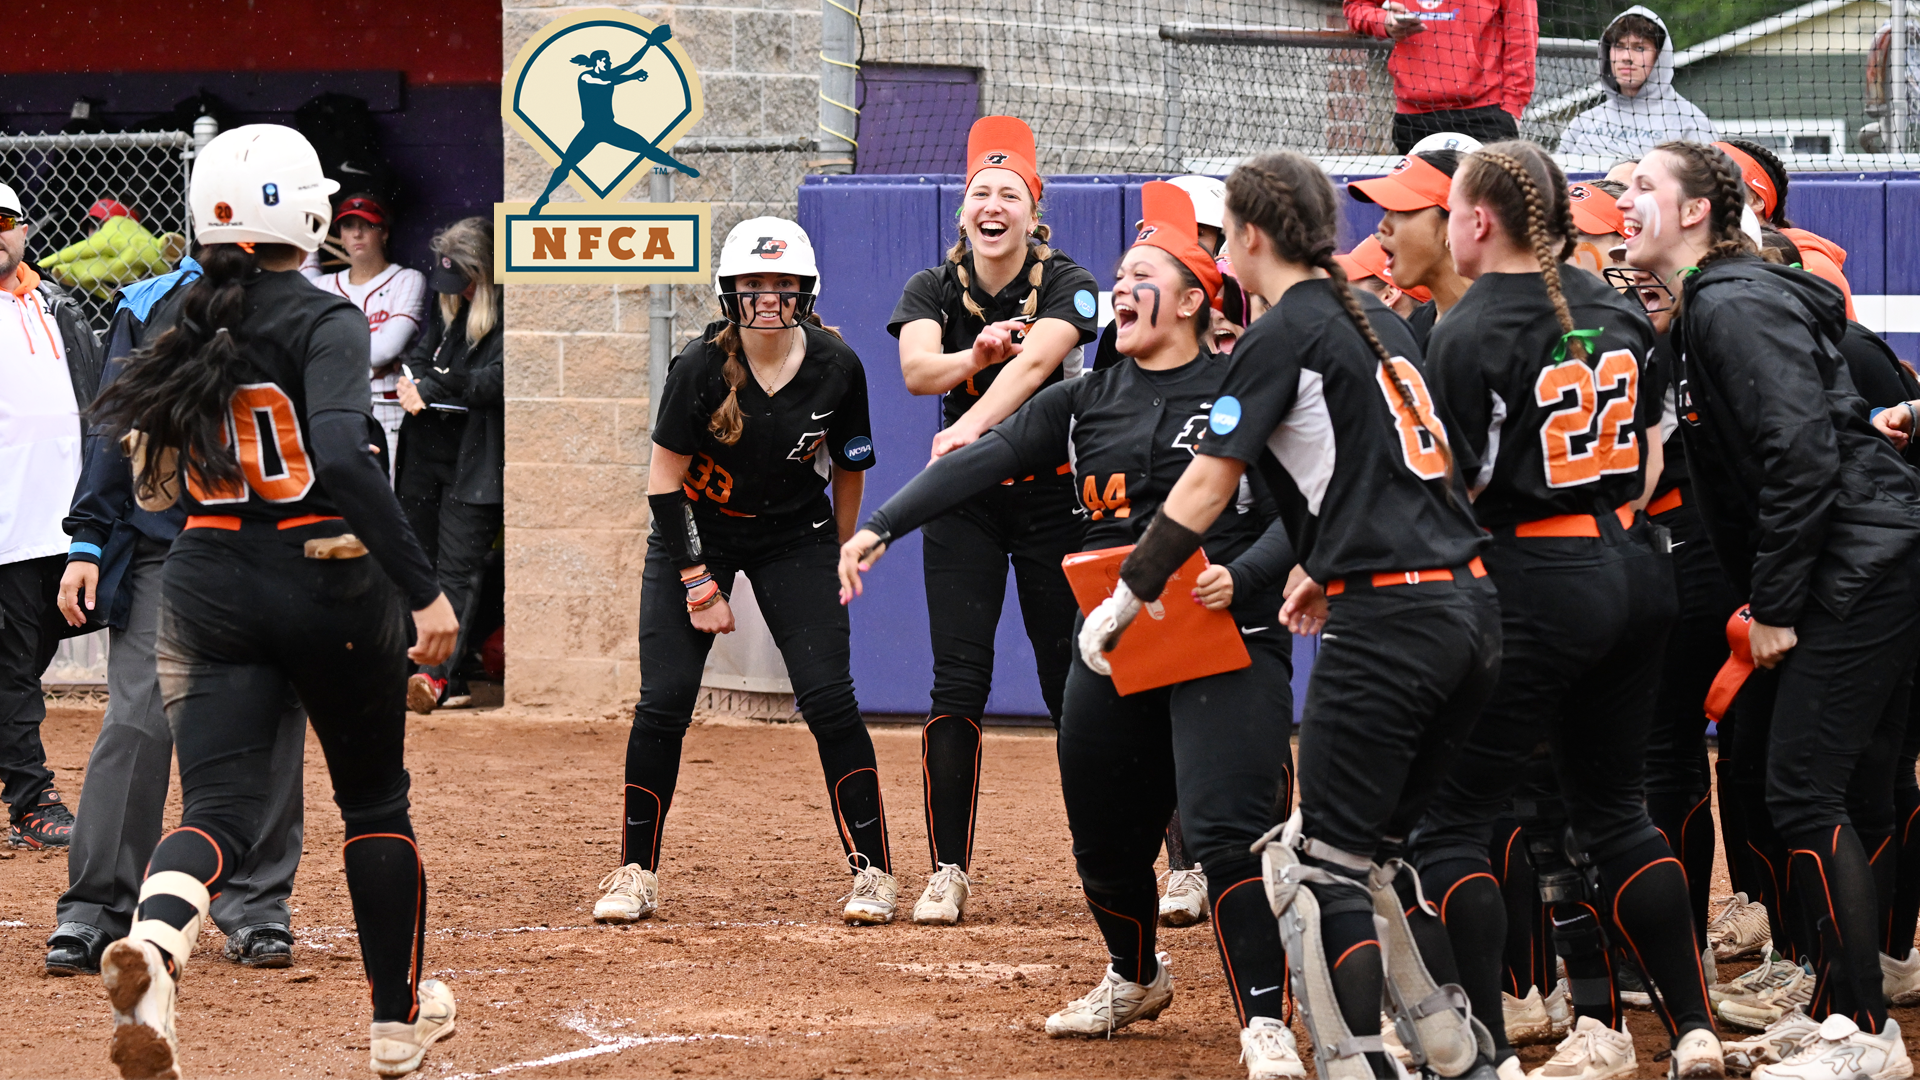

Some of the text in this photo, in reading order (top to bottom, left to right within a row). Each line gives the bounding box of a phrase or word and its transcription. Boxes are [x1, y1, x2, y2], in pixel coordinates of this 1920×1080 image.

[217, 206, 231, 219] 20
[1376, 356, 1449, 480] 8
[1534, 349, 1640, 489] 22
[849, 444, 871, 457] NCAA
[686, 452, 733, 504] 33
[1083, 473, 1131, 521] 44
